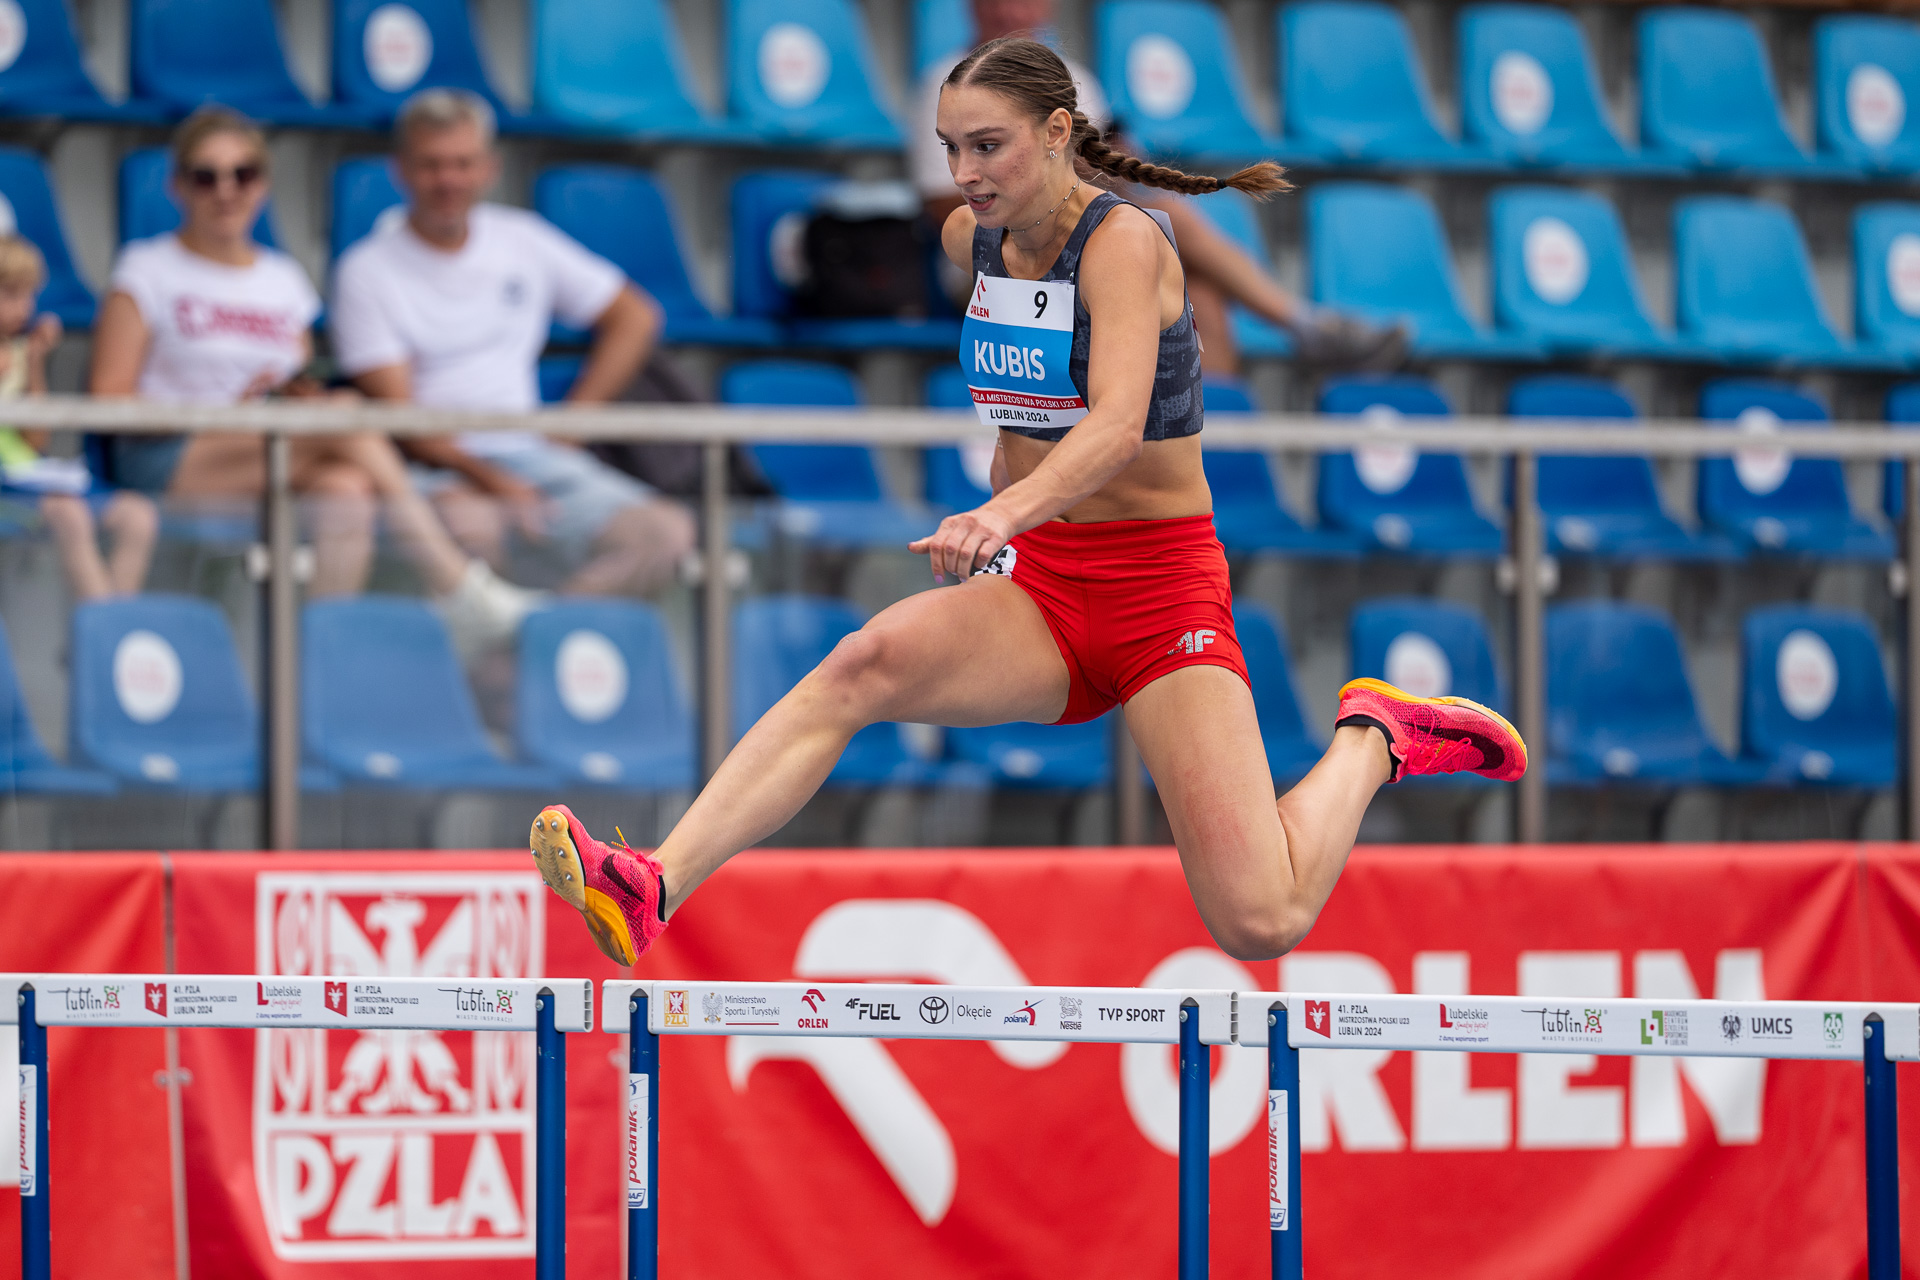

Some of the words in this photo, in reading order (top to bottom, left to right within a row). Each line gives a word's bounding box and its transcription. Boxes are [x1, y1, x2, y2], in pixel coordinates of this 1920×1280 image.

[1034, 291, 1047, 319] 9
[970, 304, 989, 318] ORLEN
[974, 339, 1045, 381] KUBIS
[972, 391, 985, 401] PZLA
[986, 393, 1035, 406] MISTRZOSTWA
[1035, 399, 1059, 408] POLSKI
[1060, 400, 1076, 408] U23
[990, 409, 1025, 421] LUBLIN
[1026, 411, 1050, 423] 2024
[185, 985, 200, 994] PZLA
[354, 985, 364, 994] 41.
[366, 985, 382, 994] PZLA
[724, 995, 766, 1004] Ministerstwo
[174, 1005, 195, 1015] LUBLIN
[197, 1005, 213, 1014] 2024
[354, 1006, 376, 1014] LUBLIN
[378, 1006, 394, 1015] 2024
[725, 1007, 746, 1016] Sportu
[751, 1007, 780, 1017] Turystyki
[957, 1005, 992, 1021] Okęcie
[1099, 1007, 1123, 1021] TVP
[1126, 1008, 1165, 1023] SPORT
[1338, 1005, 1349, 1014] 41.
[1351, 1005, 1368, 1014] PZLA
[1449, 1008, 1488, 1020] lubelskie
[665, 1015, 688, 1025] PZLA
[797, 1018, 828, 1028] ORLEN
[1003, 1015, 1029, 1025] polanik
[1338, 1016, 1377, 1024] MISTRZOSTWA
[1751, 1017, 1793, 1034] UMCS
[1338, 1026, 1362, 1036] LUBLIN
[1364, 1027, 1382, 1036] 2024
[1121, 946, 1767, 1153] ORLEN
[628, 1109, 641, 1184] polanik
[273, 1131, 524, 1239] PZLA
